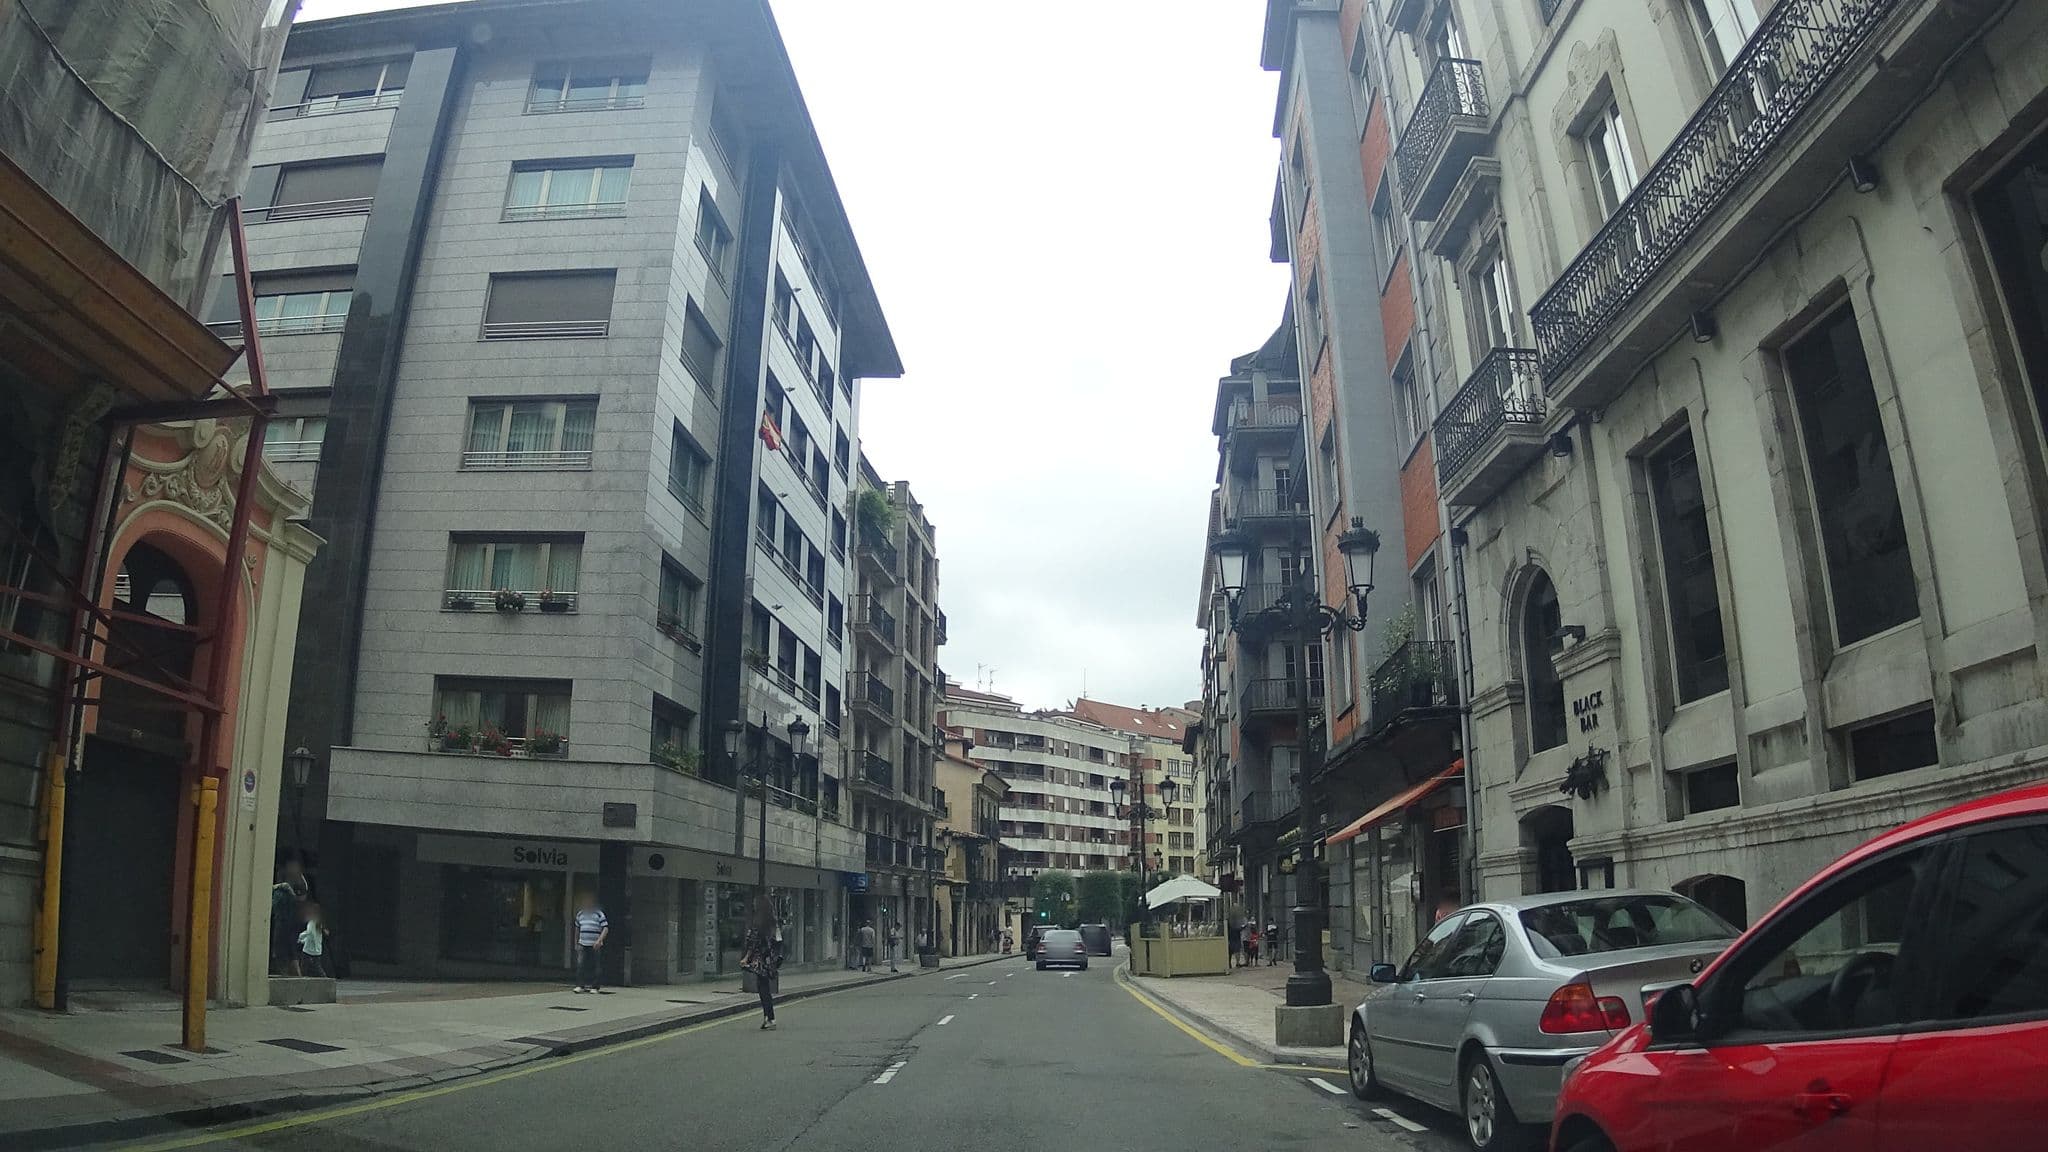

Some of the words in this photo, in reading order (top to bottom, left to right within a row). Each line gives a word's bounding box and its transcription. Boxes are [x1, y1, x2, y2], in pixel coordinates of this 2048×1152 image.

[1573, 690, 1603, 717] BLACK
[1580, 713, 1599, 734] BAR
[513, 846, 568, 866] Solvia
